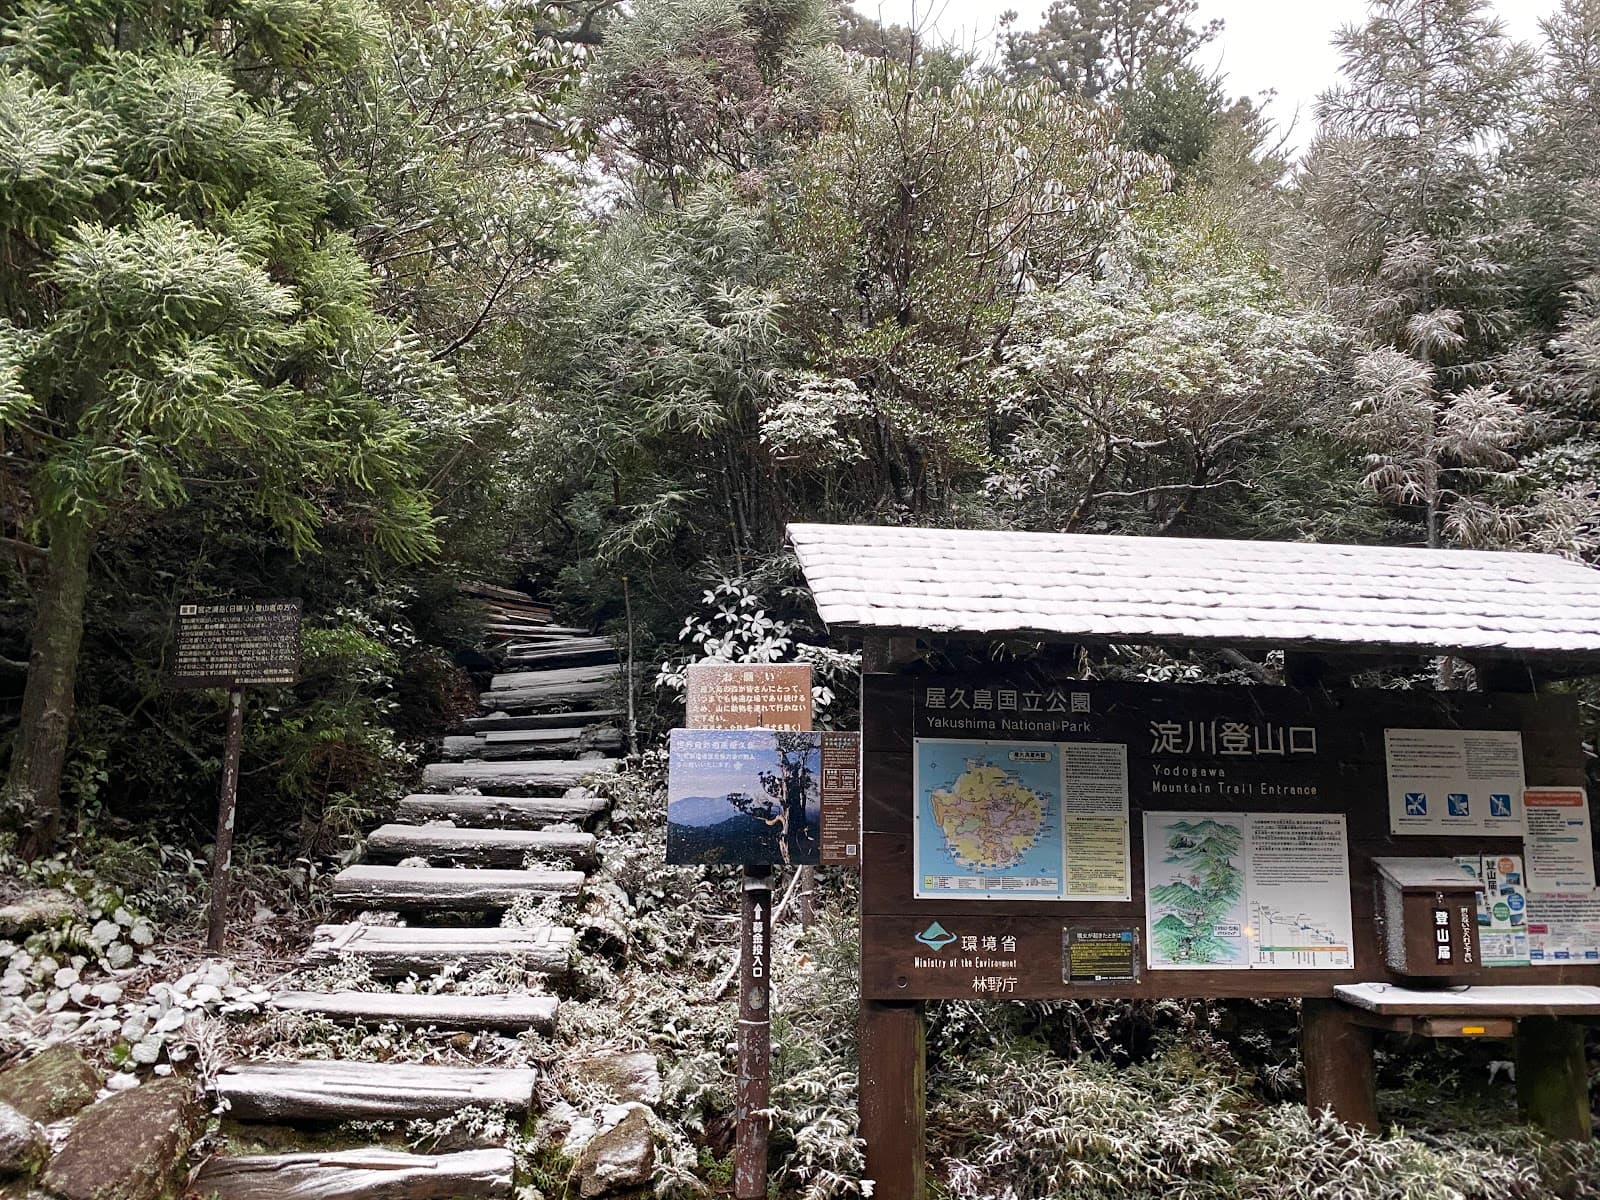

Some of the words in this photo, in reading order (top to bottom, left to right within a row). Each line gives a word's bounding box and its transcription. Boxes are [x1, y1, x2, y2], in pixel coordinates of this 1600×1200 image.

[925, 687, 1091, 713] 屋久島国立公園
[926, 717, 996, 729] Yakushima
[1001, 719, 1056, 731] National
[1061, 721, 1091, 732] Park
[1150, 720, 1317, 755] 淀川登山口
[1152, 764, 1225, 777] Yodogawa
[1152, 781, 1211, 793] Mountain
[1218, 782, 1253, 794] Trail
[1261, 783, 1317, 795] Entrance
[961, 935, 1017, 952] 環境省
[1435, 911, 1451, 959] 登山届
[752, 922, 764, 978] 募金投入口
[914, 956, 946, 969] Ministry
[949, 957, 957, 968] of
[961, 957, 973, 968] the
[975, 956, 1017, 968] Environment
[972, 975, 1018, 993] 林野庁
